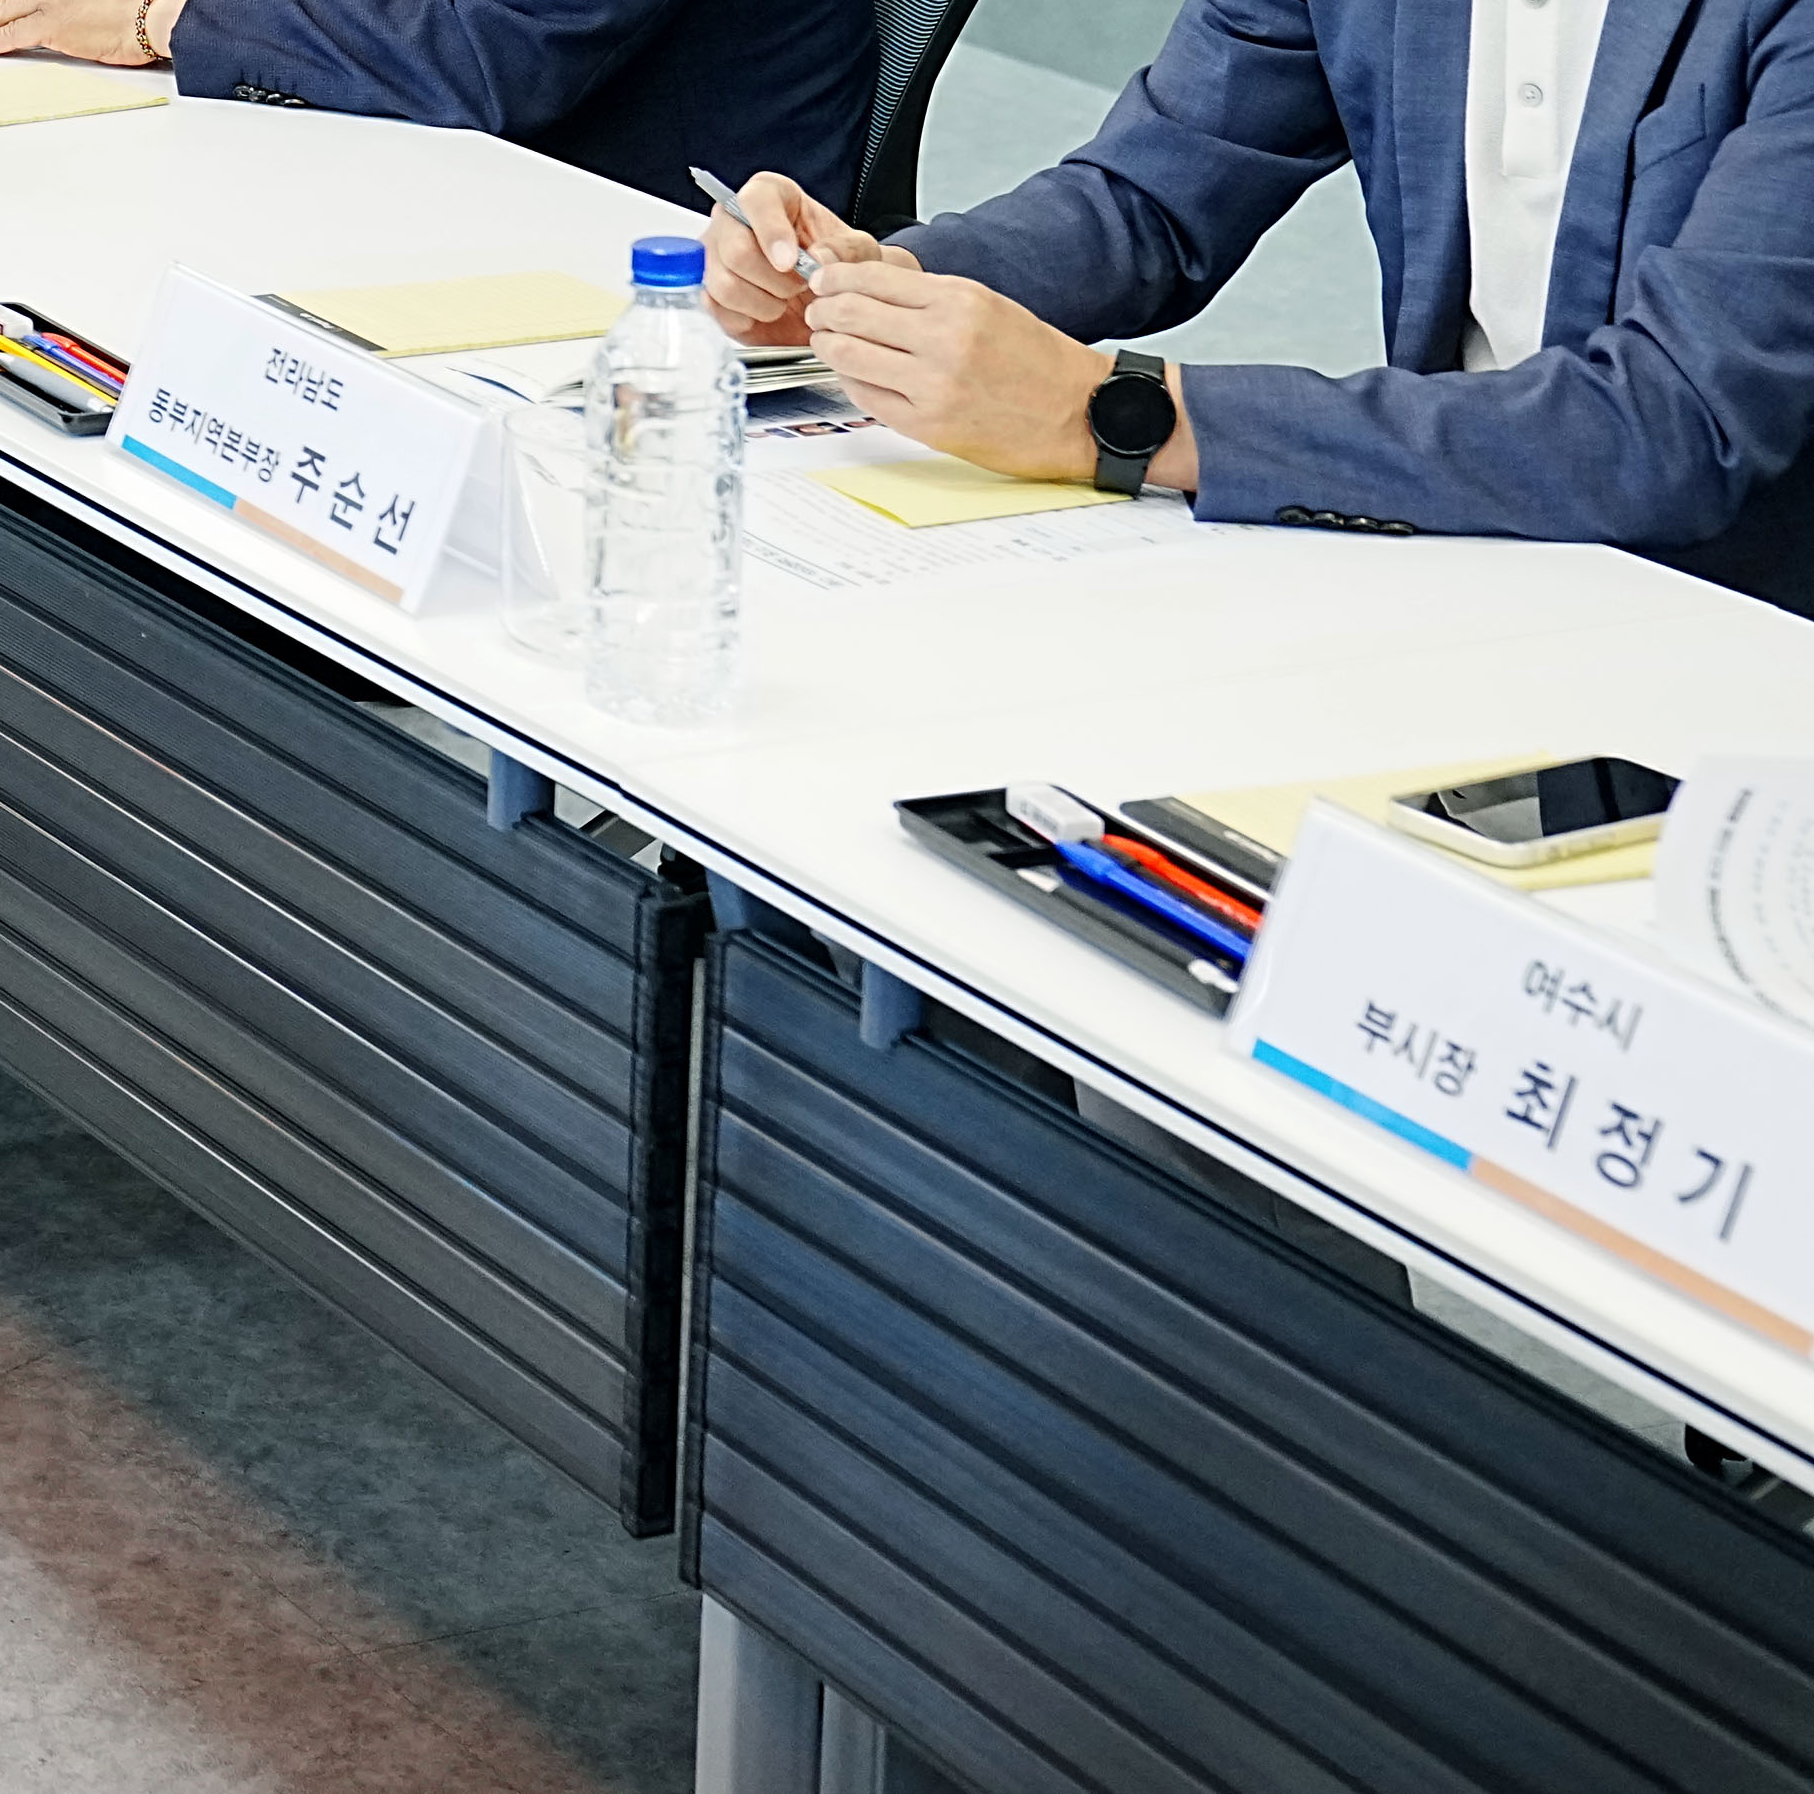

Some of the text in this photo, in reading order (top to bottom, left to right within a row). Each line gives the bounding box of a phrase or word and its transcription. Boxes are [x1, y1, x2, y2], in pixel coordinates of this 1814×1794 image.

[263, 345, 345, 413] 전라남도
[147, 387, 418, 556] 동부지역본부장 주순선
[1522, 957, 1644, 1054] 여수시
[1354, 999, 1754, 1242] 부시장 최정기
